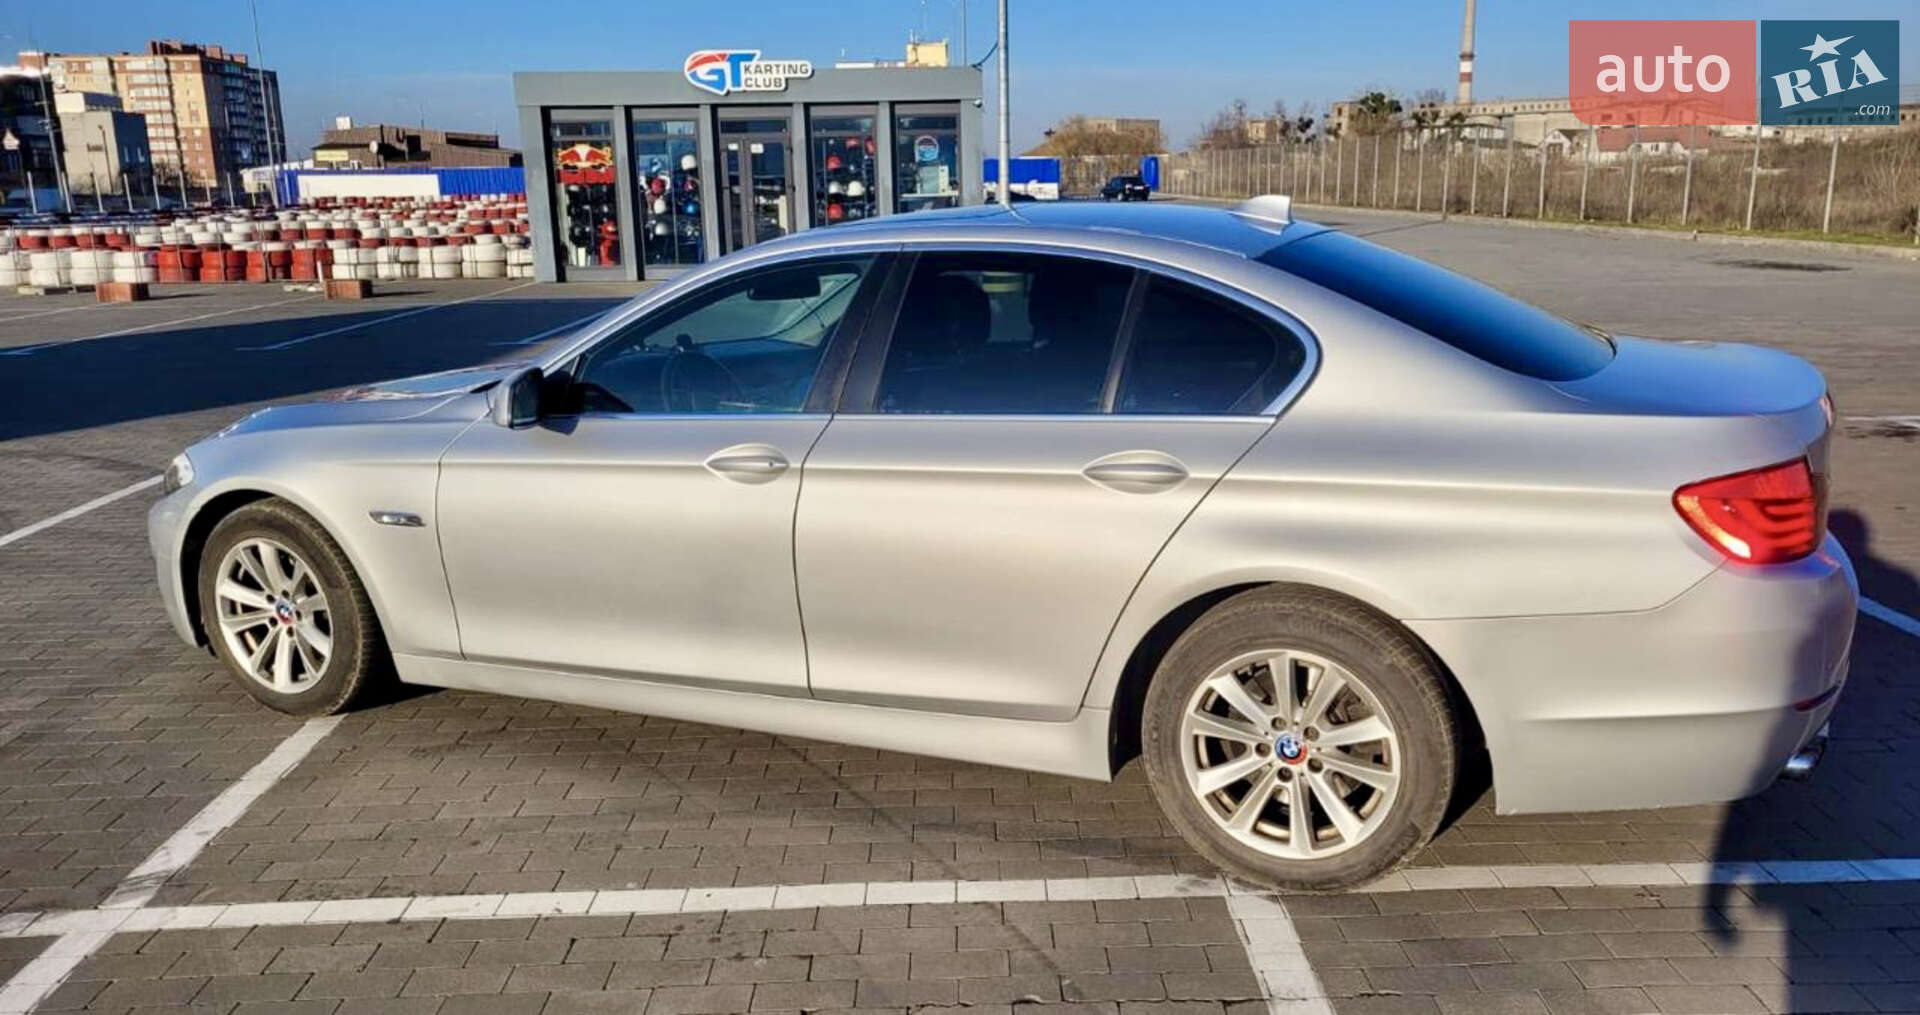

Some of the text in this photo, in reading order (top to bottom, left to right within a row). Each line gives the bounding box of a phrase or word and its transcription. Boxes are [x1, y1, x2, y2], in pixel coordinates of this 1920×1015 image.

[686, 53, 758, 92] GT
[744, 63, 809, 74] KARTING
[744, 77, 783, 88] CLUB
